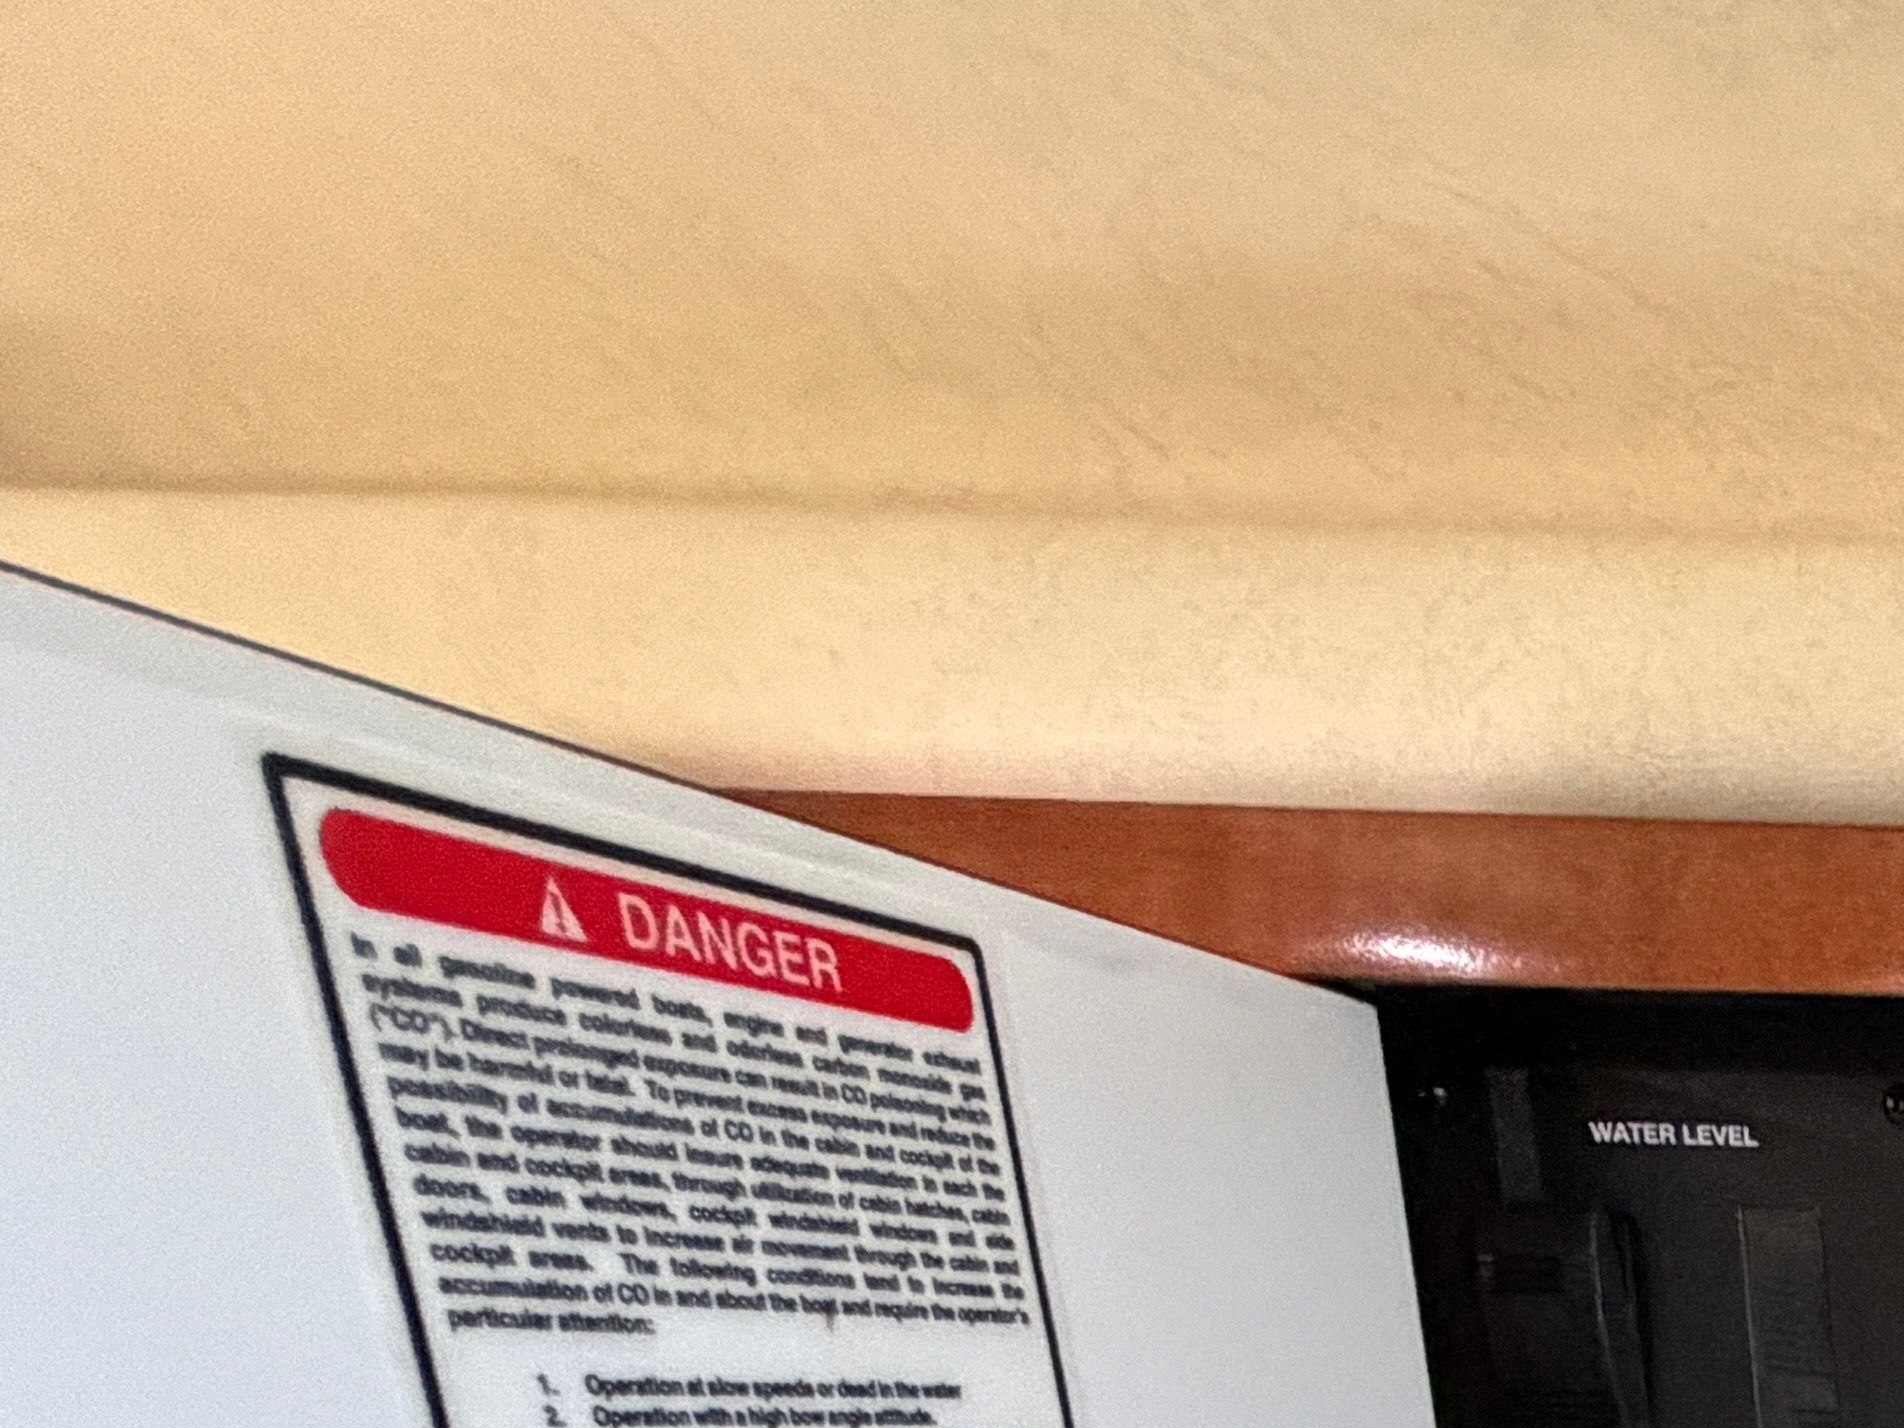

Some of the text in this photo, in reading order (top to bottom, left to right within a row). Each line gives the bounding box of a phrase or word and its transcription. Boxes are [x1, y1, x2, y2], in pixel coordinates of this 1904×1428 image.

[617, 892, 842, 992] DANGER
[1588, 1121, 1760, 1147] WATER LEVEL
